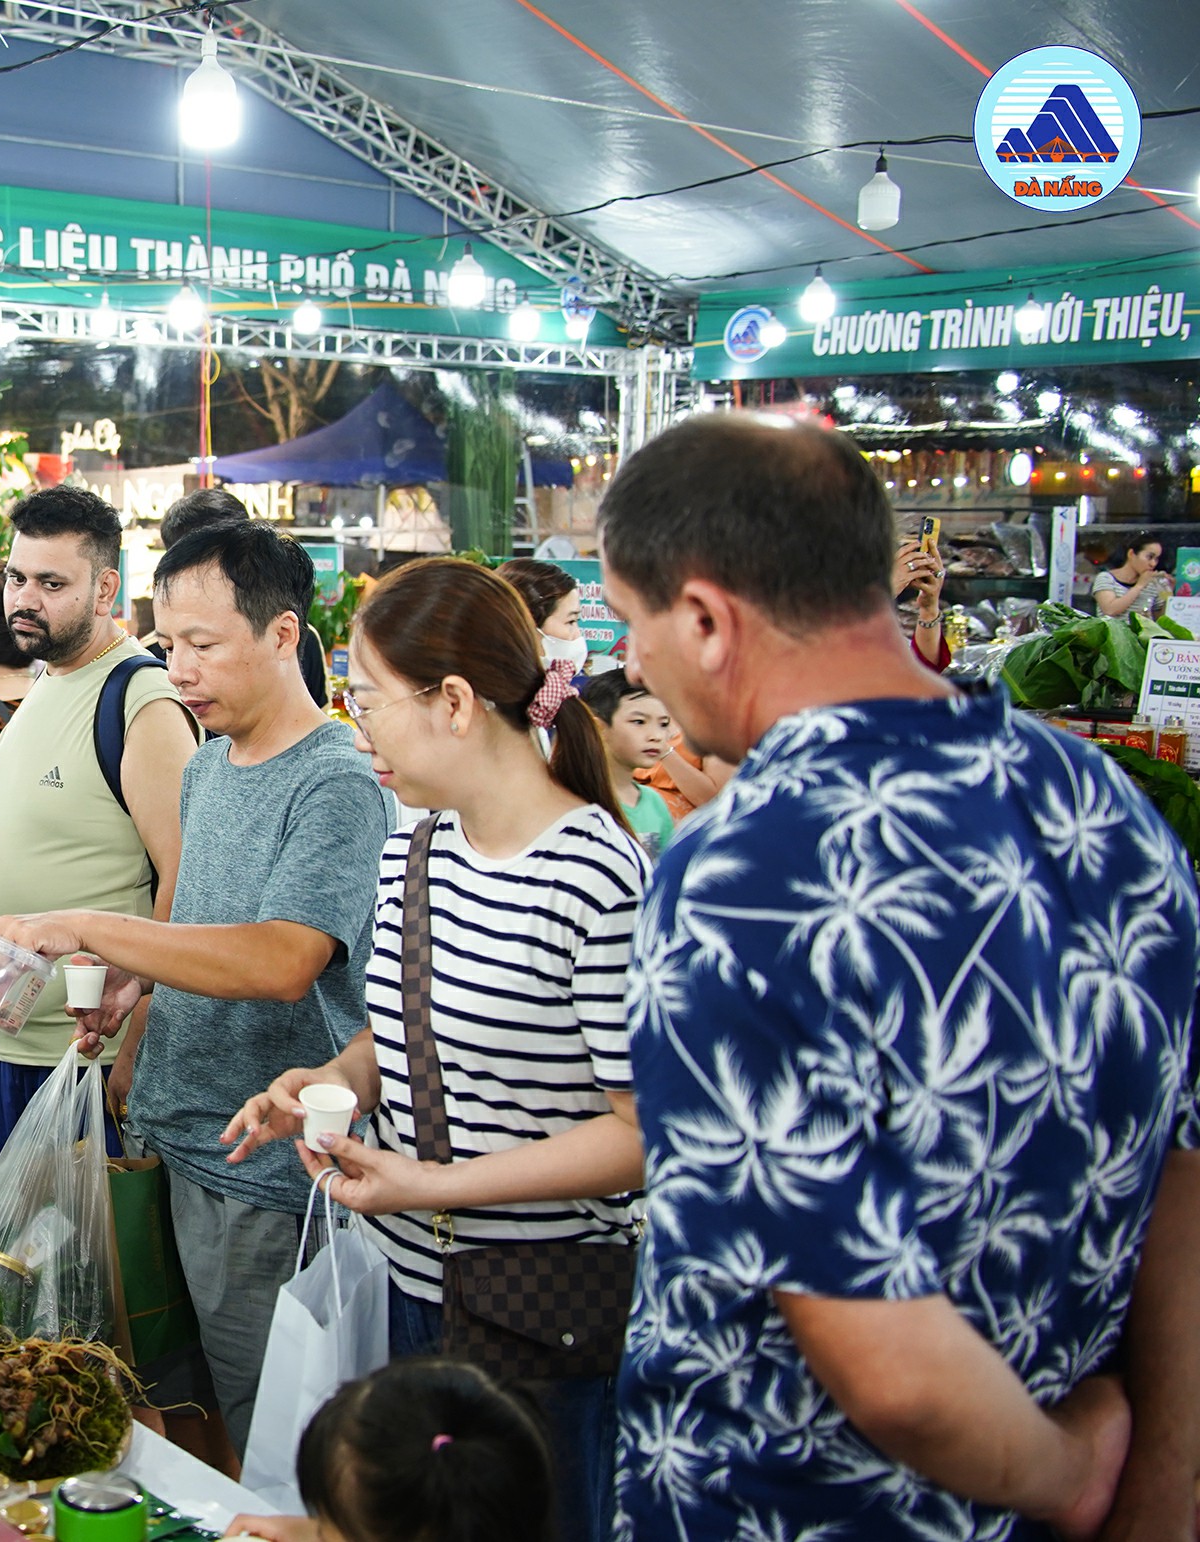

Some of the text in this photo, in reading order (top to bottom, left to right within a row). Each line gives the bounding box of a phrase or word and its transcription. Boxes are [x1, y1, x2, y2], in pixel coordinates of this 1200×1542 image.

[18, 222, 118, 282] LIỆU
[130, 235, 269, 290] THÀNH
[279, 248, 356, 298] PHỐ
[364, 258, 414, 305] ĐÀ
[812, 309, 922, 357] CHƯƠNG
[928, 298, 1015, 351] TRÌNH
[1092, 284, 1192, 348] THIỆU,
[39, 779, 64, 789] adidas
